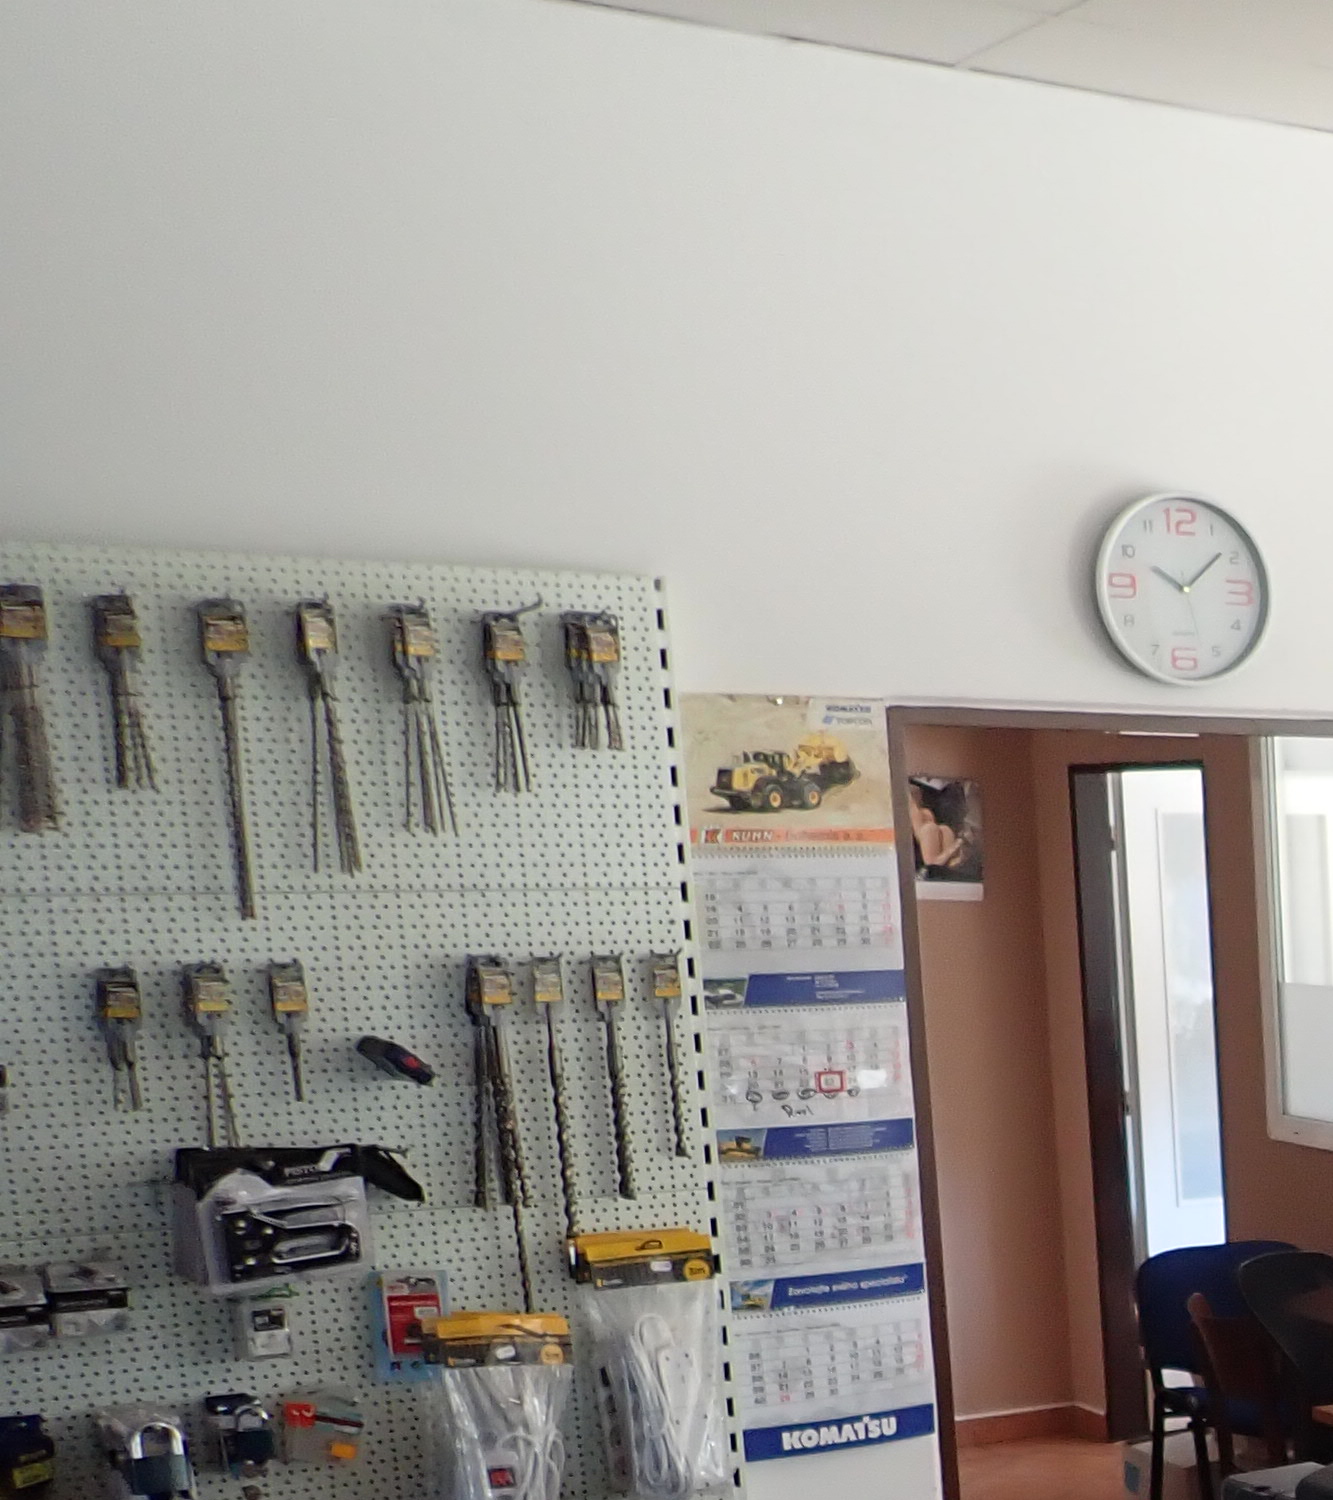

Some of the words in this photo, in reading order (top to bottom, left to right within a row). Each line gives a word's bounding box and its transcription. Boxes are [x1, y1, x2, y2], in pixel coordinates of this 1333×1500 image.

[1163, 507, 1197, 536] 12
[1121, 544, 1136, 559] 10
[1229, 551, 1240, 564] 2
[1108, 572, 1137, 599] 9
[1225, 579, 1254, 607] 3
[1123, 613, 1135, 627] 8
[1230, 618, 1242, 631] 4
[1171, 647, 1198, 671] 6
[731, 831, 773, 841] KUHN
[781, 1416, 897, 1450] KOMATSU
